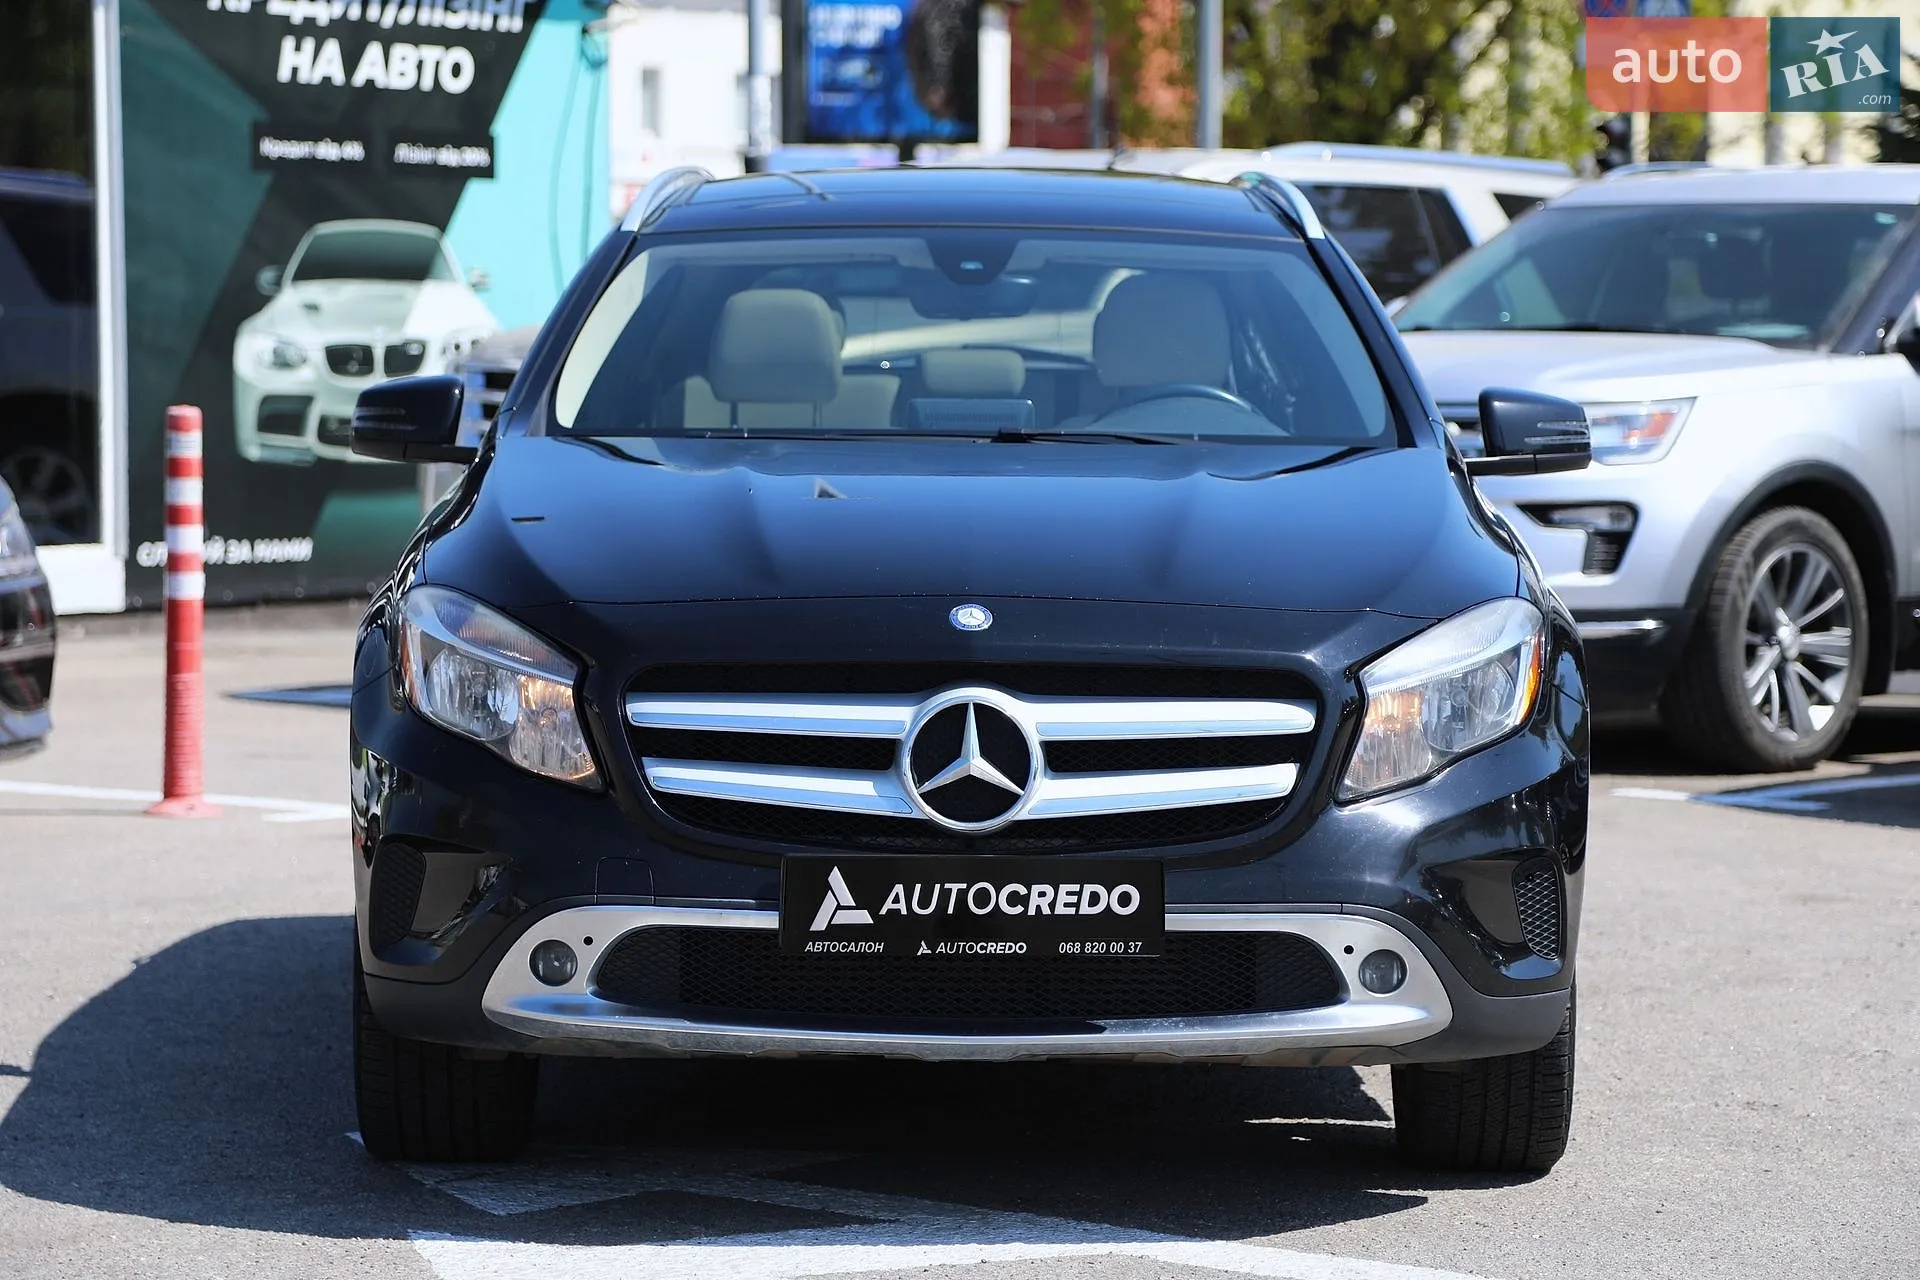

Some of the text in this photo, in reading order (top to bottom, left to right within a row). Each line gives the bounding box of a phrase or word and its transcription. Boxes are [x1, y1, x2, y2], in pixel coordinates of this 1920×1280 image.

[276, 35, 475, 94] НА АВТО
[879, 881, 1141, 916] AUTOCREDO
[804, 941, 884, 953] АВТОСАЛОН
[935, 941, 1027, 954] AUTOCREDO
[1058, 941, 1143, 954] 068 820 00 37
